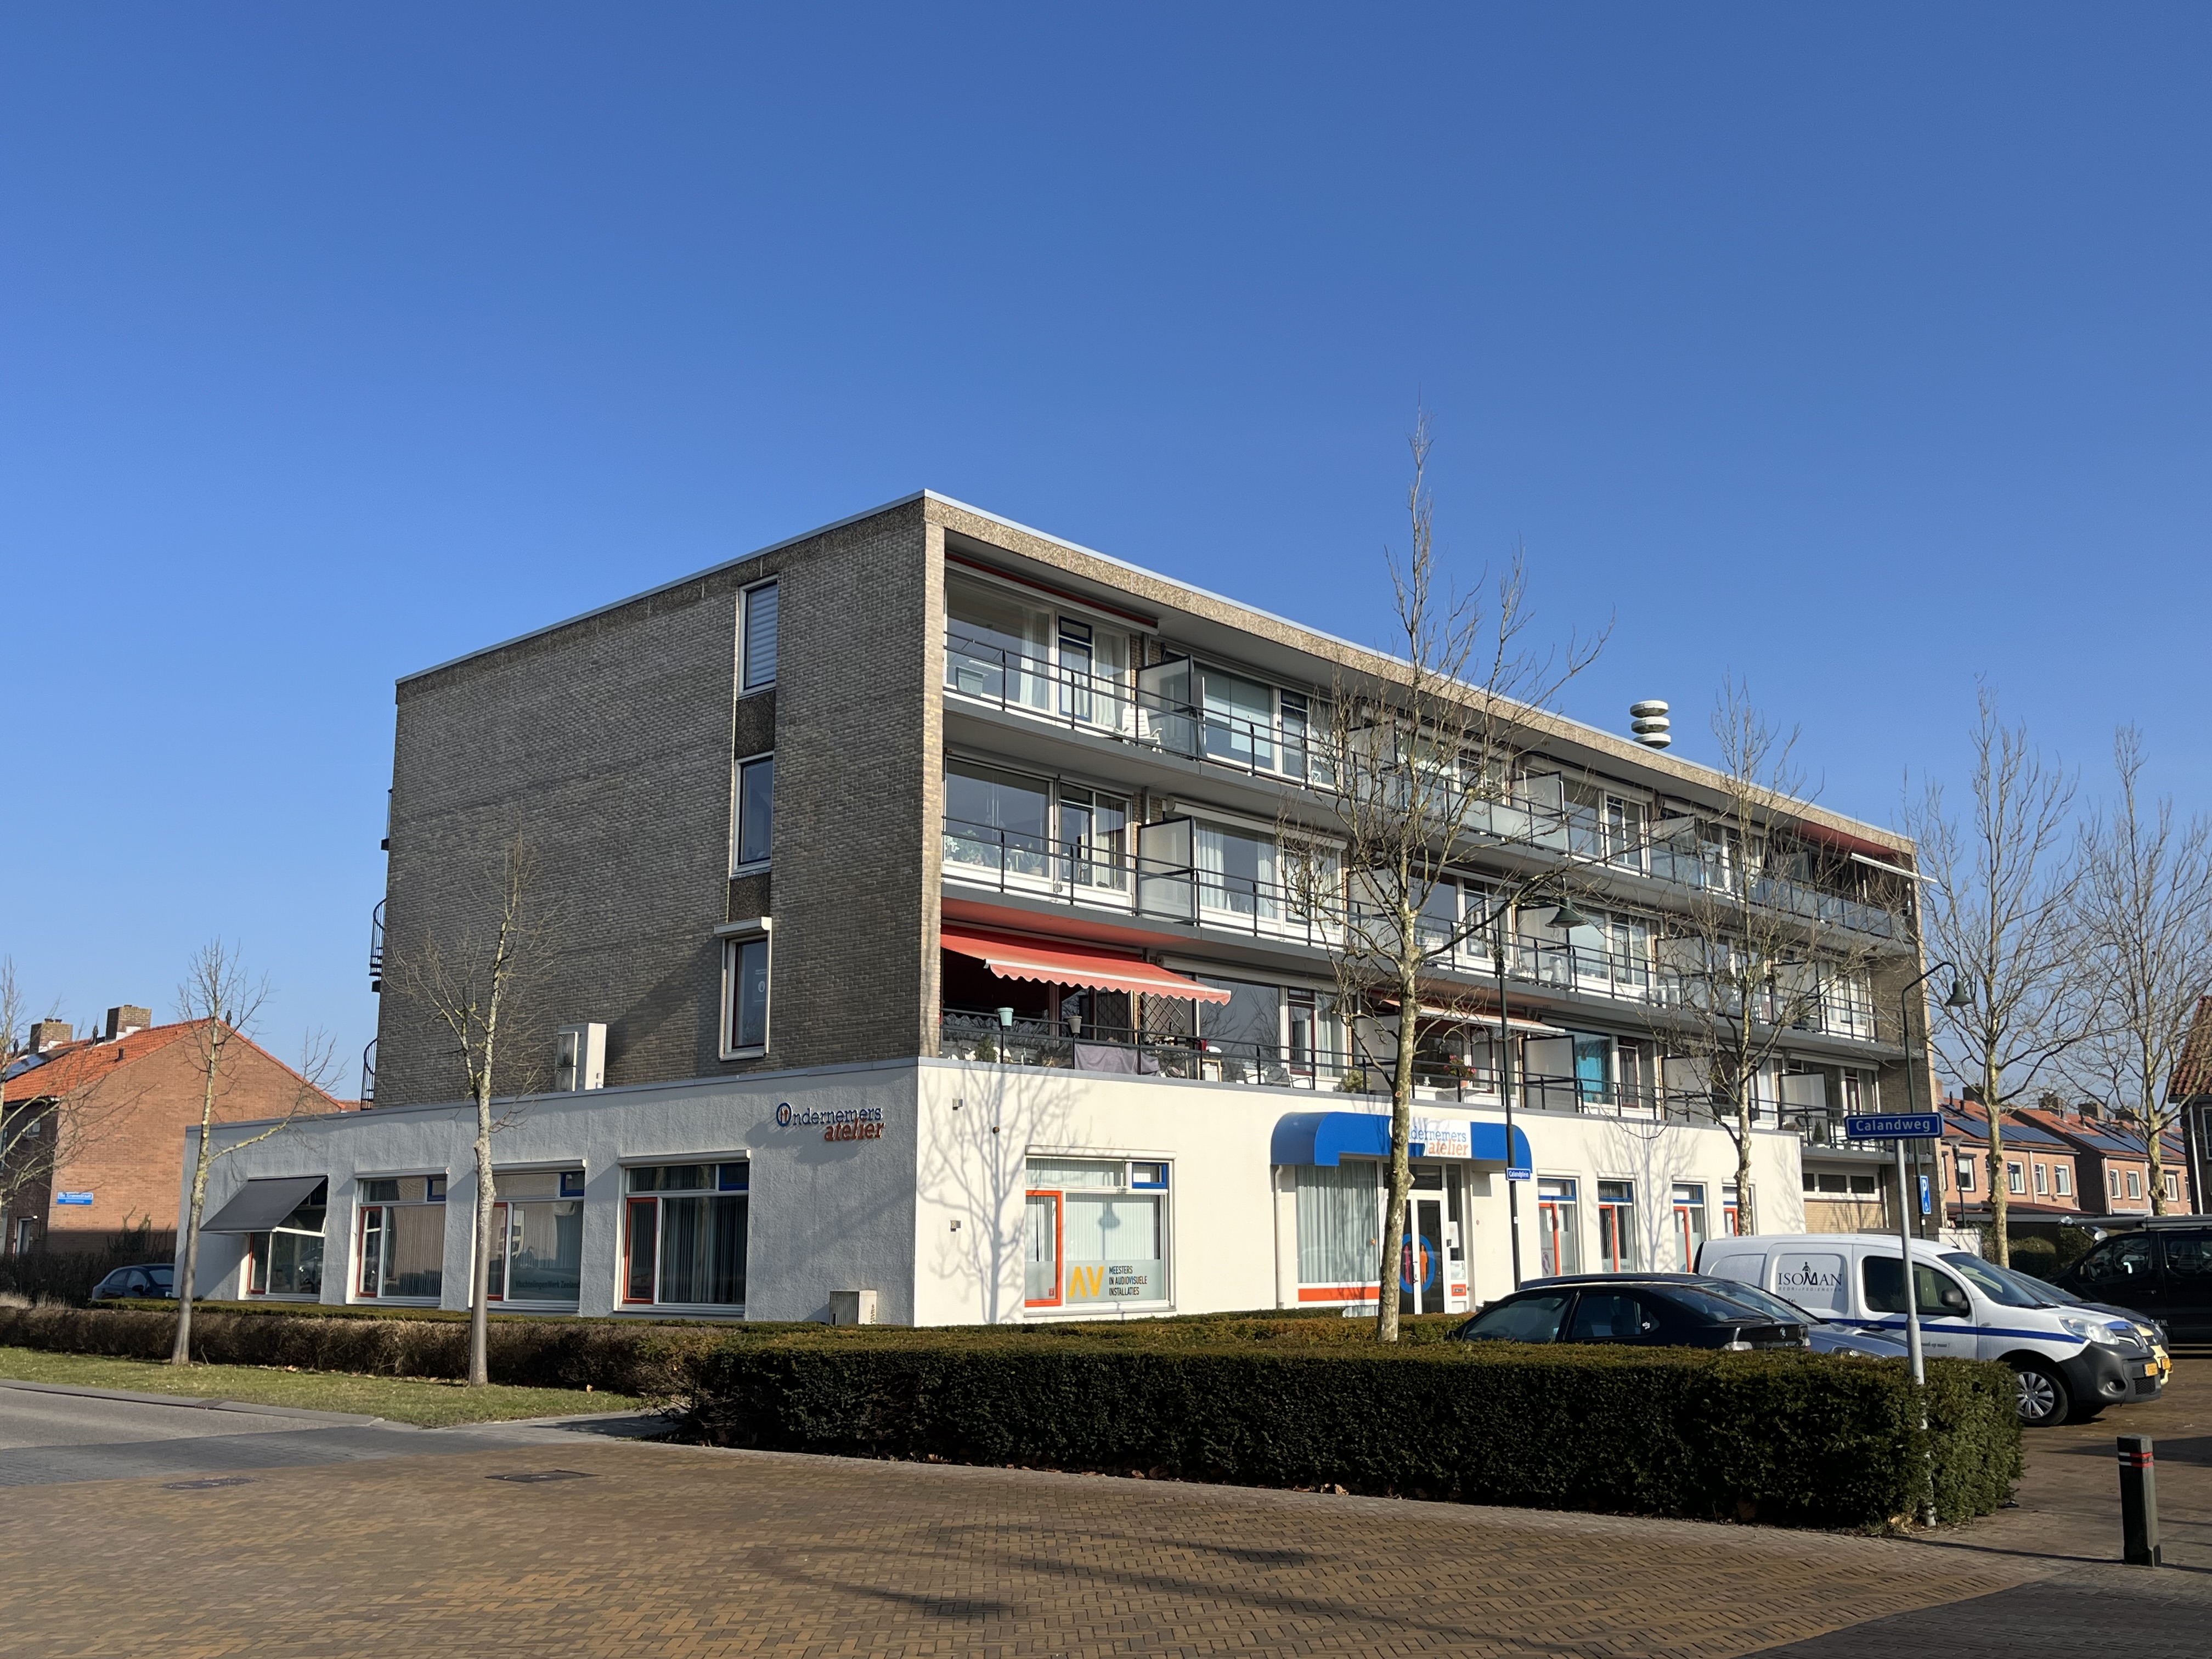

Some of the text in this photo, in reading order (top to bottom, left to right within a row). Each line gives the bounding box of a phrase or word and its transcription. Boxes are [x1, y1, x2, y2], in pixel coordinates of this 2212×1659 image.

[776, 1102, 883, 1127] Ondernemers
[824, 1118, 886, 1142] atelier
[1856, 1119, 1931, 1132] Calandweg
[1408, 1126, 1467, 1143] dernemers
[1429, 1138, 1469, 1156] atelier
[1922, 1179, 1927, 1198] P
[1109, 1266, 1133, 1274] MEESTERS
[1068, 1266, 1105, 1298] AV
[1109, 1276, 1148, 1285] IN AUDIOVISUELE
[1778, 1272, 1843, 1286] ISOMAN
[1109, 1286, 1140, 1296] INSTALLATIES
